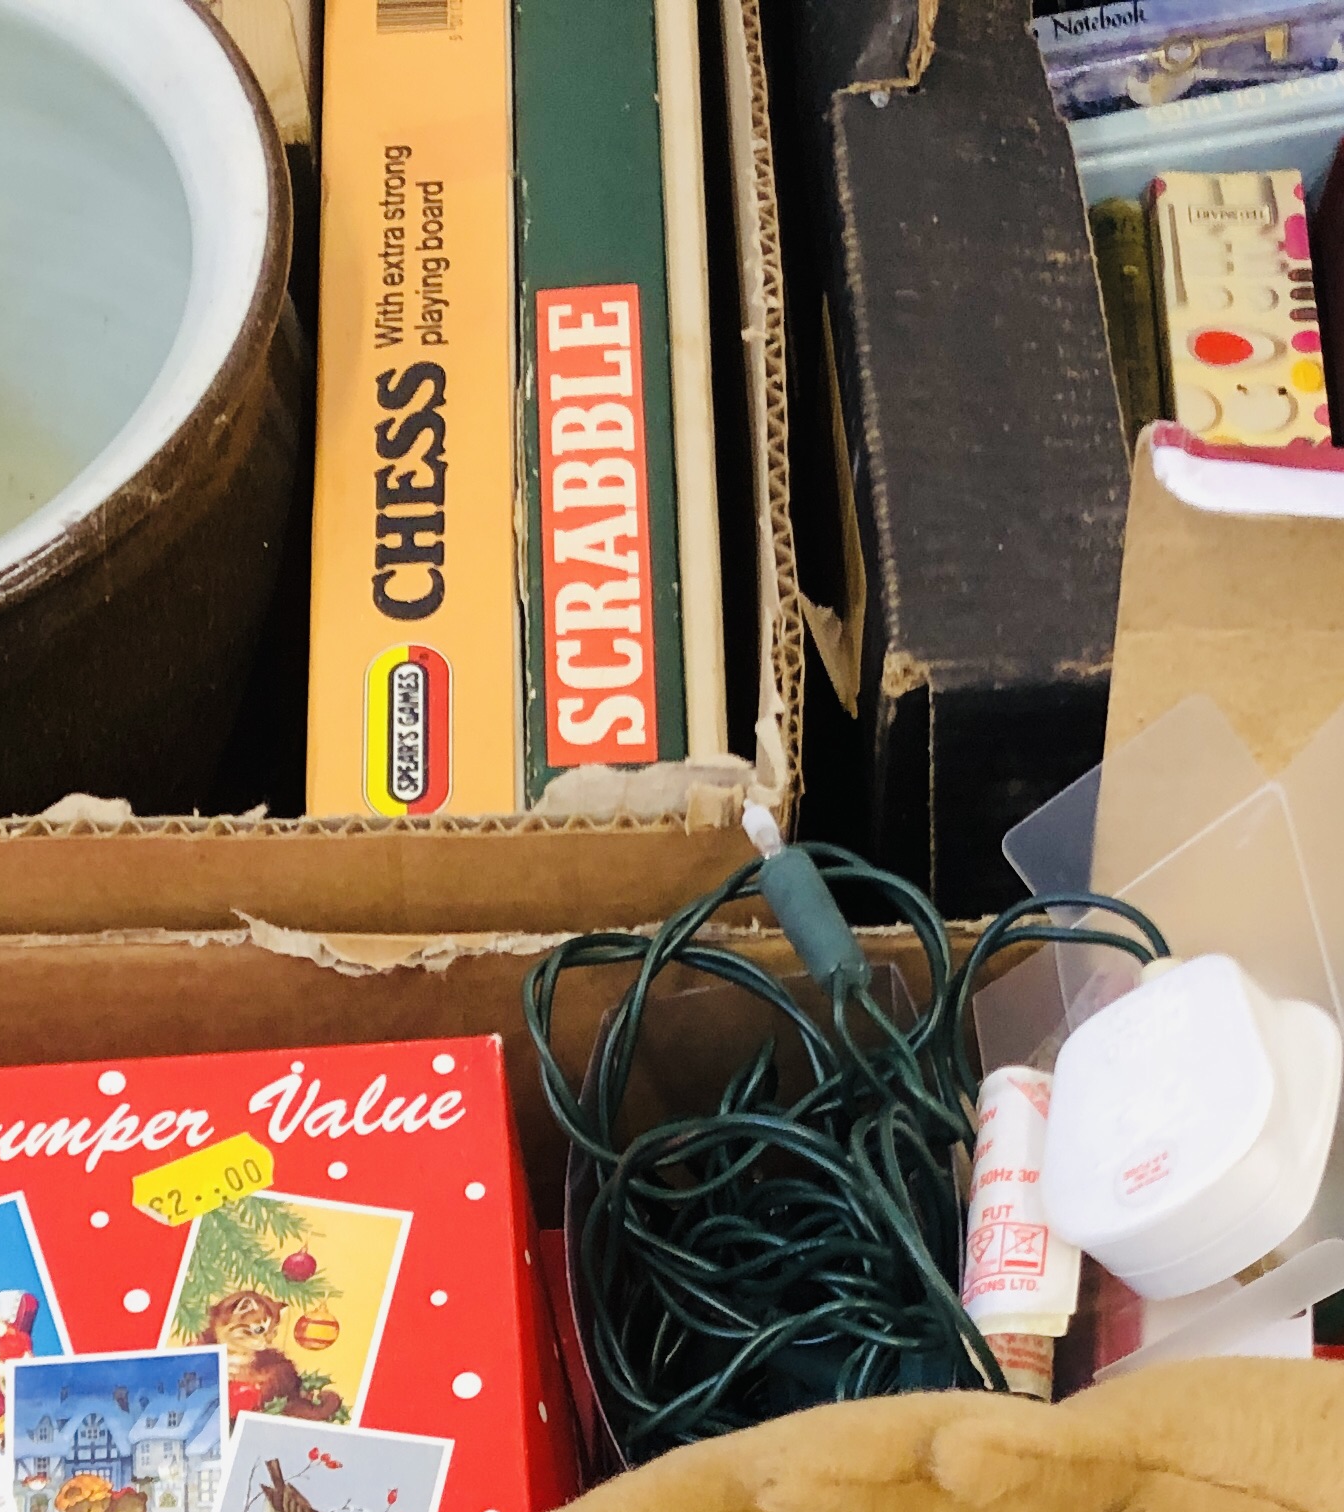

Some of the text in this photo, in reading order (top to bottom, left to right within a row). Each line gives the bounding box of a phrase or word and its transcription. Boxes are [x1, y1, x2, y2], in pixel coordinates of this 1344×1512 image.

[1050, 0, 1148, 40] Notebook
[375, 144, 412, 349] With extra strong
[414, 181, 450, 347] playing board
[372, 361, 448, 621] CHESS
[548, 300, 646, 746] SCRABBLE
[397, 671, 420, 793] SPEAR'S GAMES
[248, 1071, 466, 1146] Value
[982, 1204, 1014, 1223] FUT
